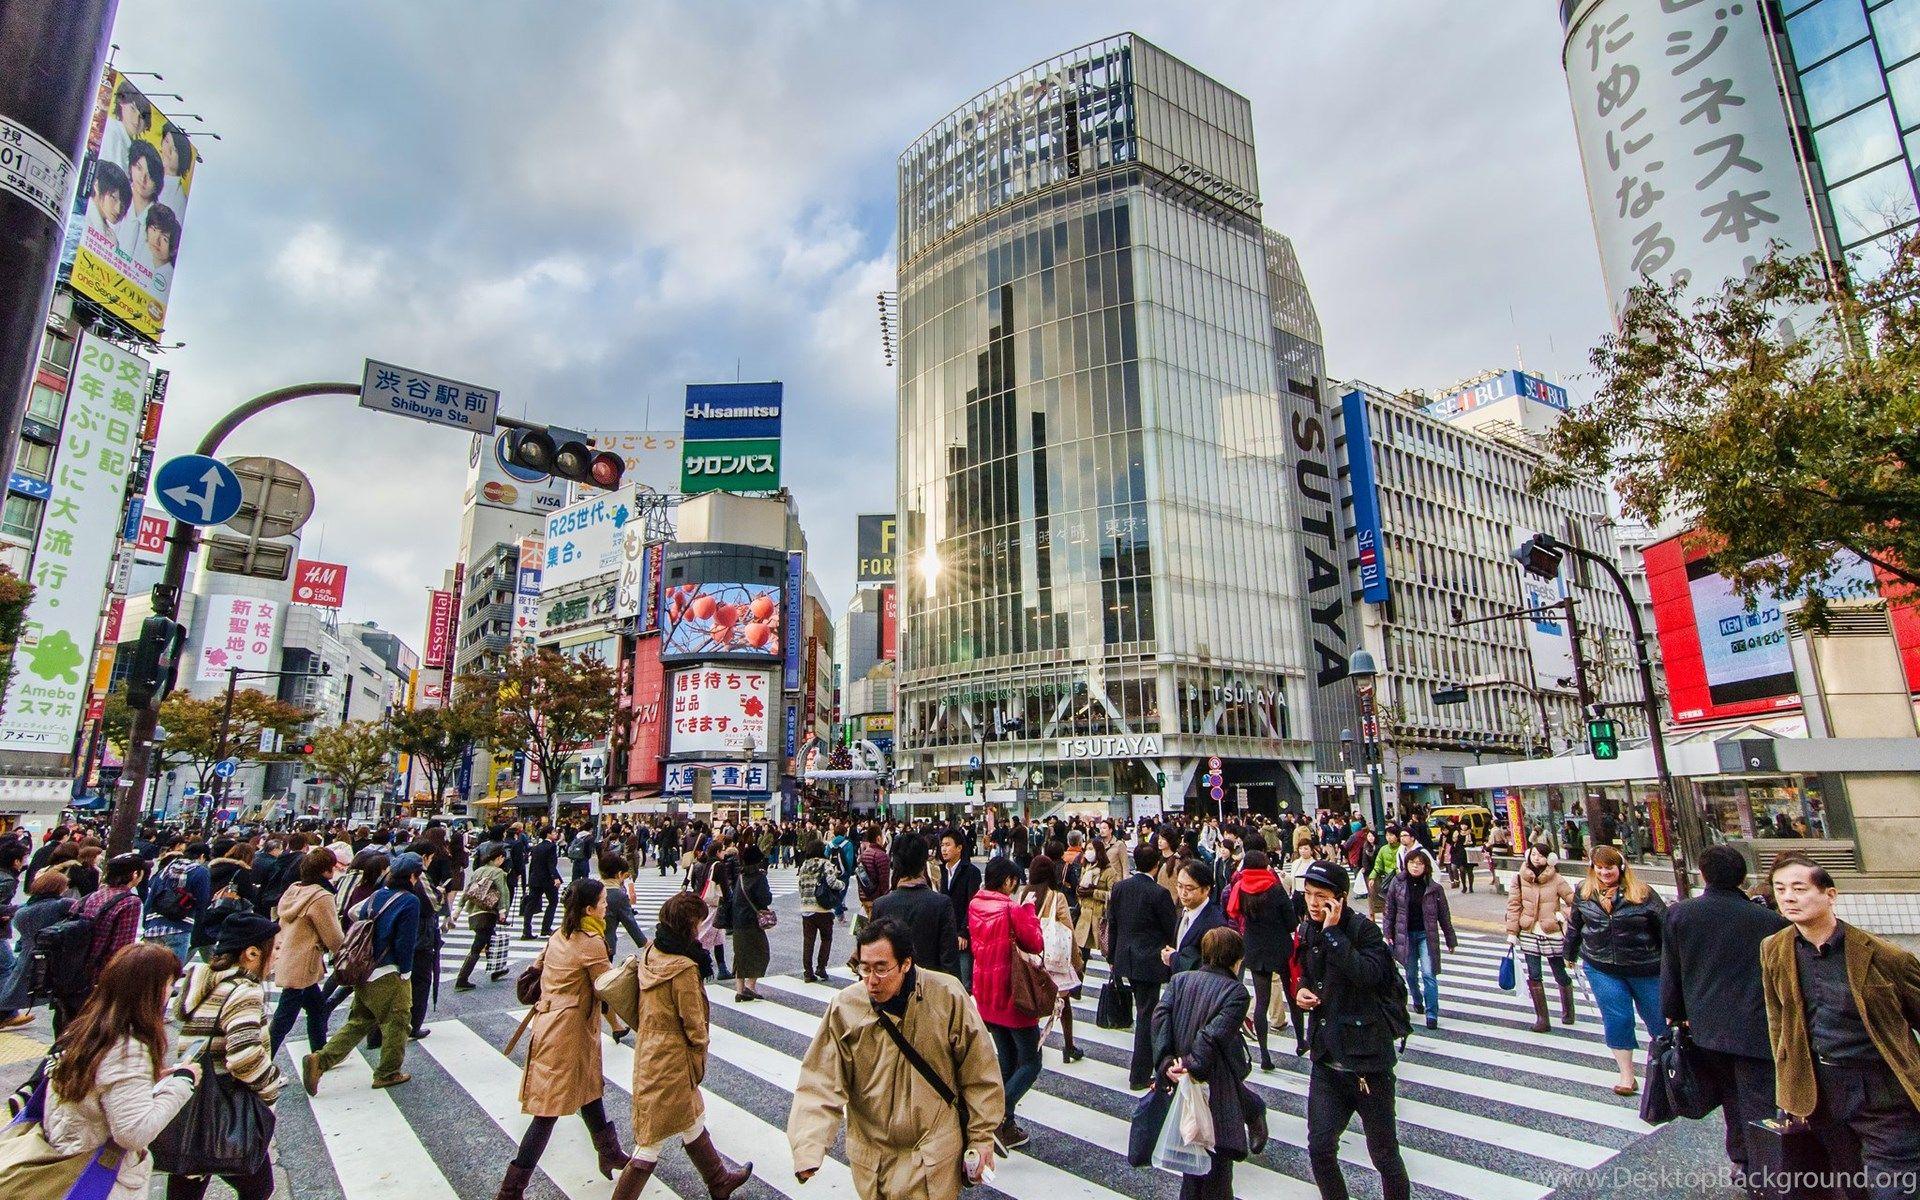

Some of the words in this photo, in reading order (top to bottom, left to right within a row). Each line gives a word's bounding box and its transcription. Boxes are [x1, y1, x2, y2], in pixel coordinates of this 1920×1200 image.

[1660, 0, 1780, 278] ジネス本
[87, 225, 115, 249] HAPPY
[115, 246, 133, 263] NEW
[133, 260, 154, 280] YEAR
[375, 369, 489, 414] 渋谷駅前
[1434, 378, 1504, 416] SEIBU
[1525, 377, 1565, 408] SEIBU
[391, 396, 443, 418] Shibuya
[447, 409, 472, 424] Sta.
[685, 403, 779, 419] Hisamitsu
[98, 359, 141, 493] 交換日記、
[685, 455, 774, 475] サロンパス
[537, 495, 561, 508] VISA
[550, 501, 611, 539] R25世代、
[1287, 376, 1350, 688] TSUTAYA
[546, 541, 582, 569] 集合。
[1358, 530, 1378, 589] SEIBU
[304, 566, 338, 585] H&M
[314, 593, 338, 603] 150m
[1524, 581, 1556, 601] meets
[224, 599, 252, 661] 新聖地。
[252, 603, 274, 655] 女性の
[428, 593, 449, 665] Essential
[21, 684, 76, 701] Ameba
[677, 672, 765, 692] 信号待ちで
[17, 700, 73, 716] スマホ
[675, 695, 700, 712] 出品
[1212, 684, 1286, 707] TSUTAYA
[4, 730, 48, 741] アメーバ
[675, 717, 738, 734] できます。
[1060, 735, 1159, 758] TSUTAYA
